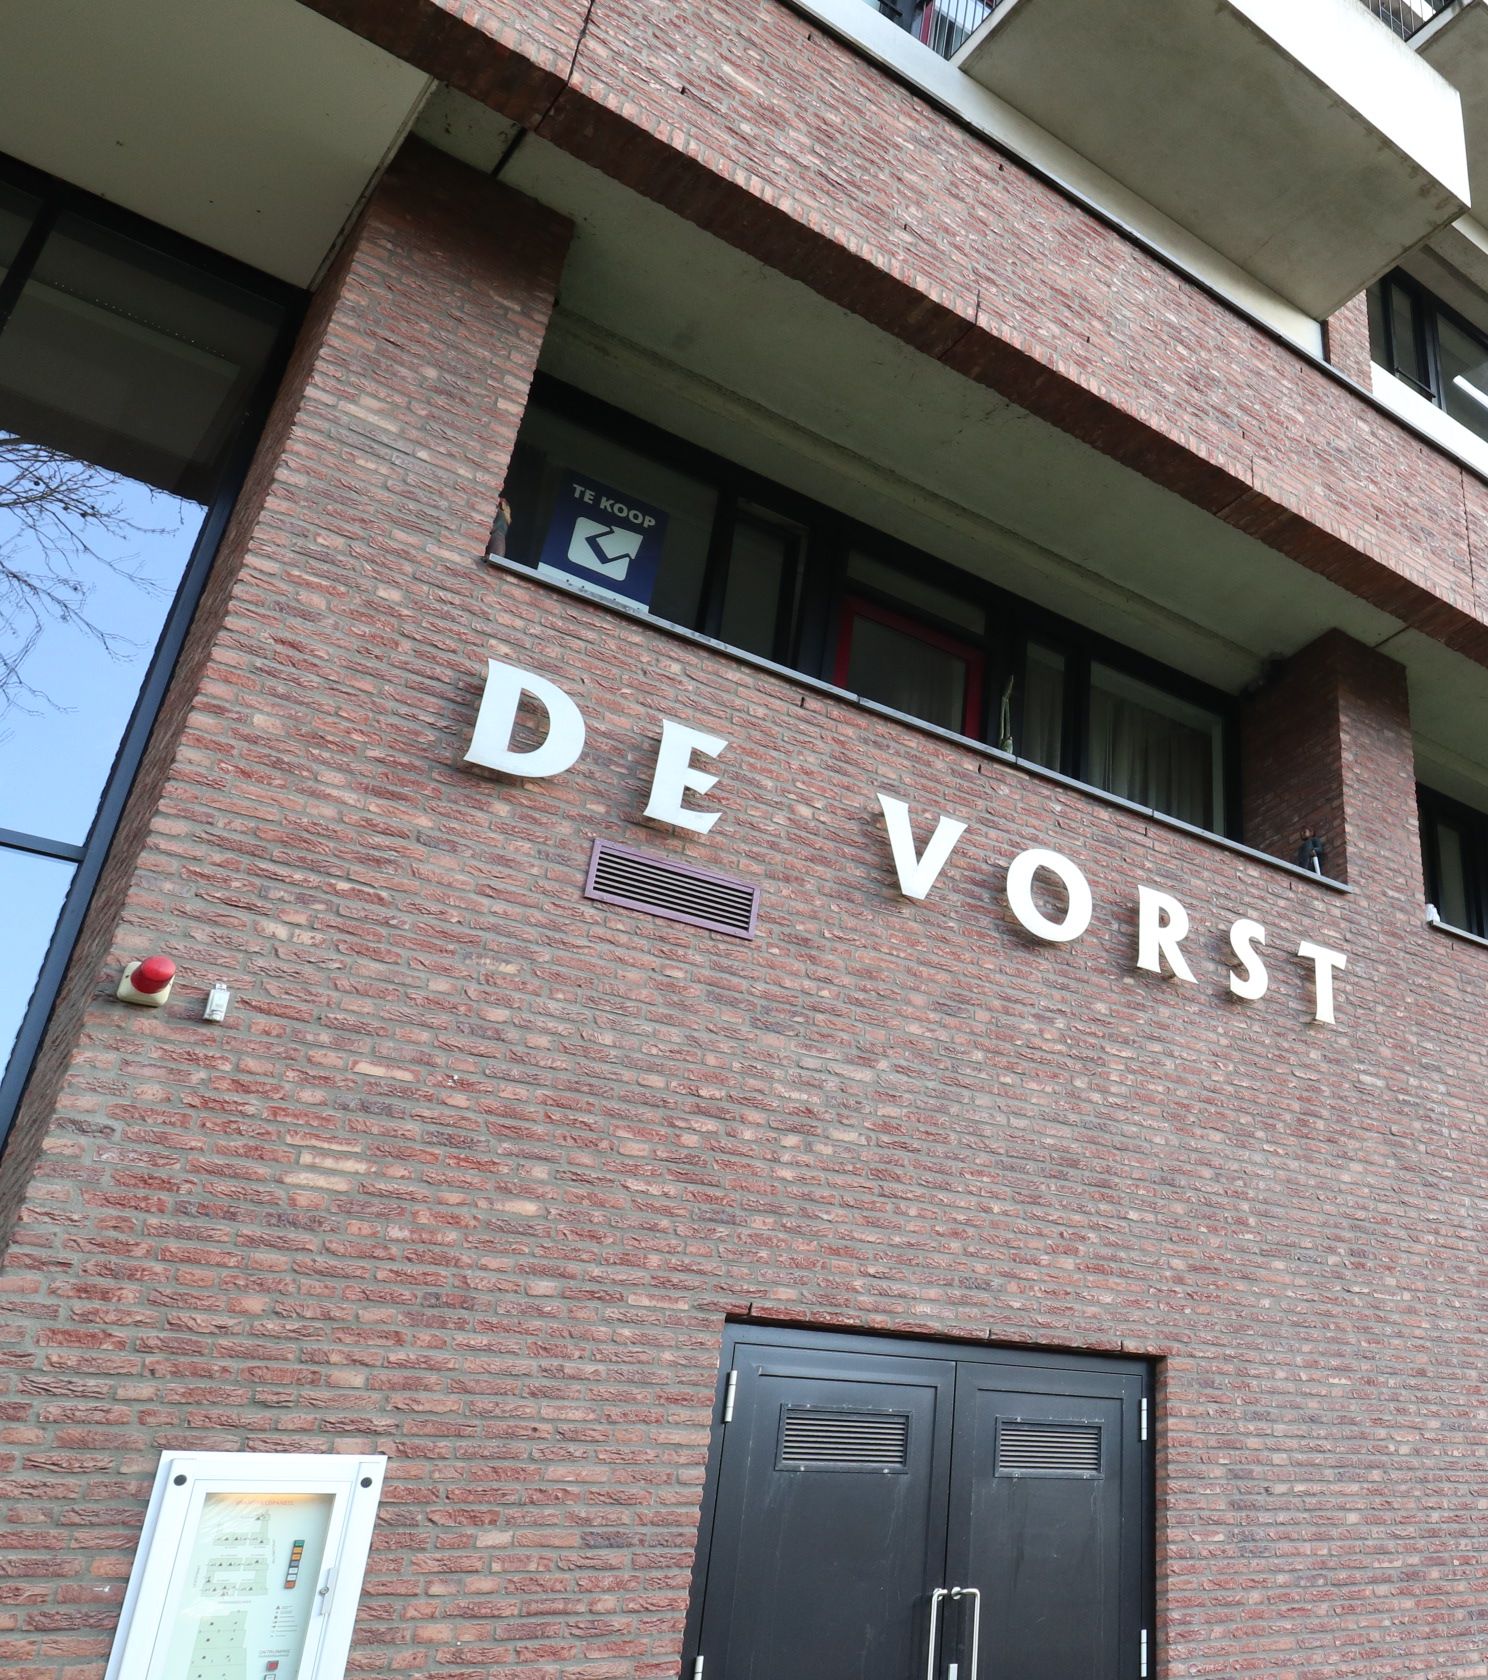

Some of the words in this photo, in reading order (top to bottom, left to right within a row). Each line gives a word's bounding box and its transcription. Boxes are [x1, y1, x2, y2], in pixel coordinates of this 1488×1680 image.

[572, 484, 595, 504] TE
[600, 496, 656, 528] KOOP
[463, 658, 727, 834] DE
[876, 792, 1347, 1025] VORST
